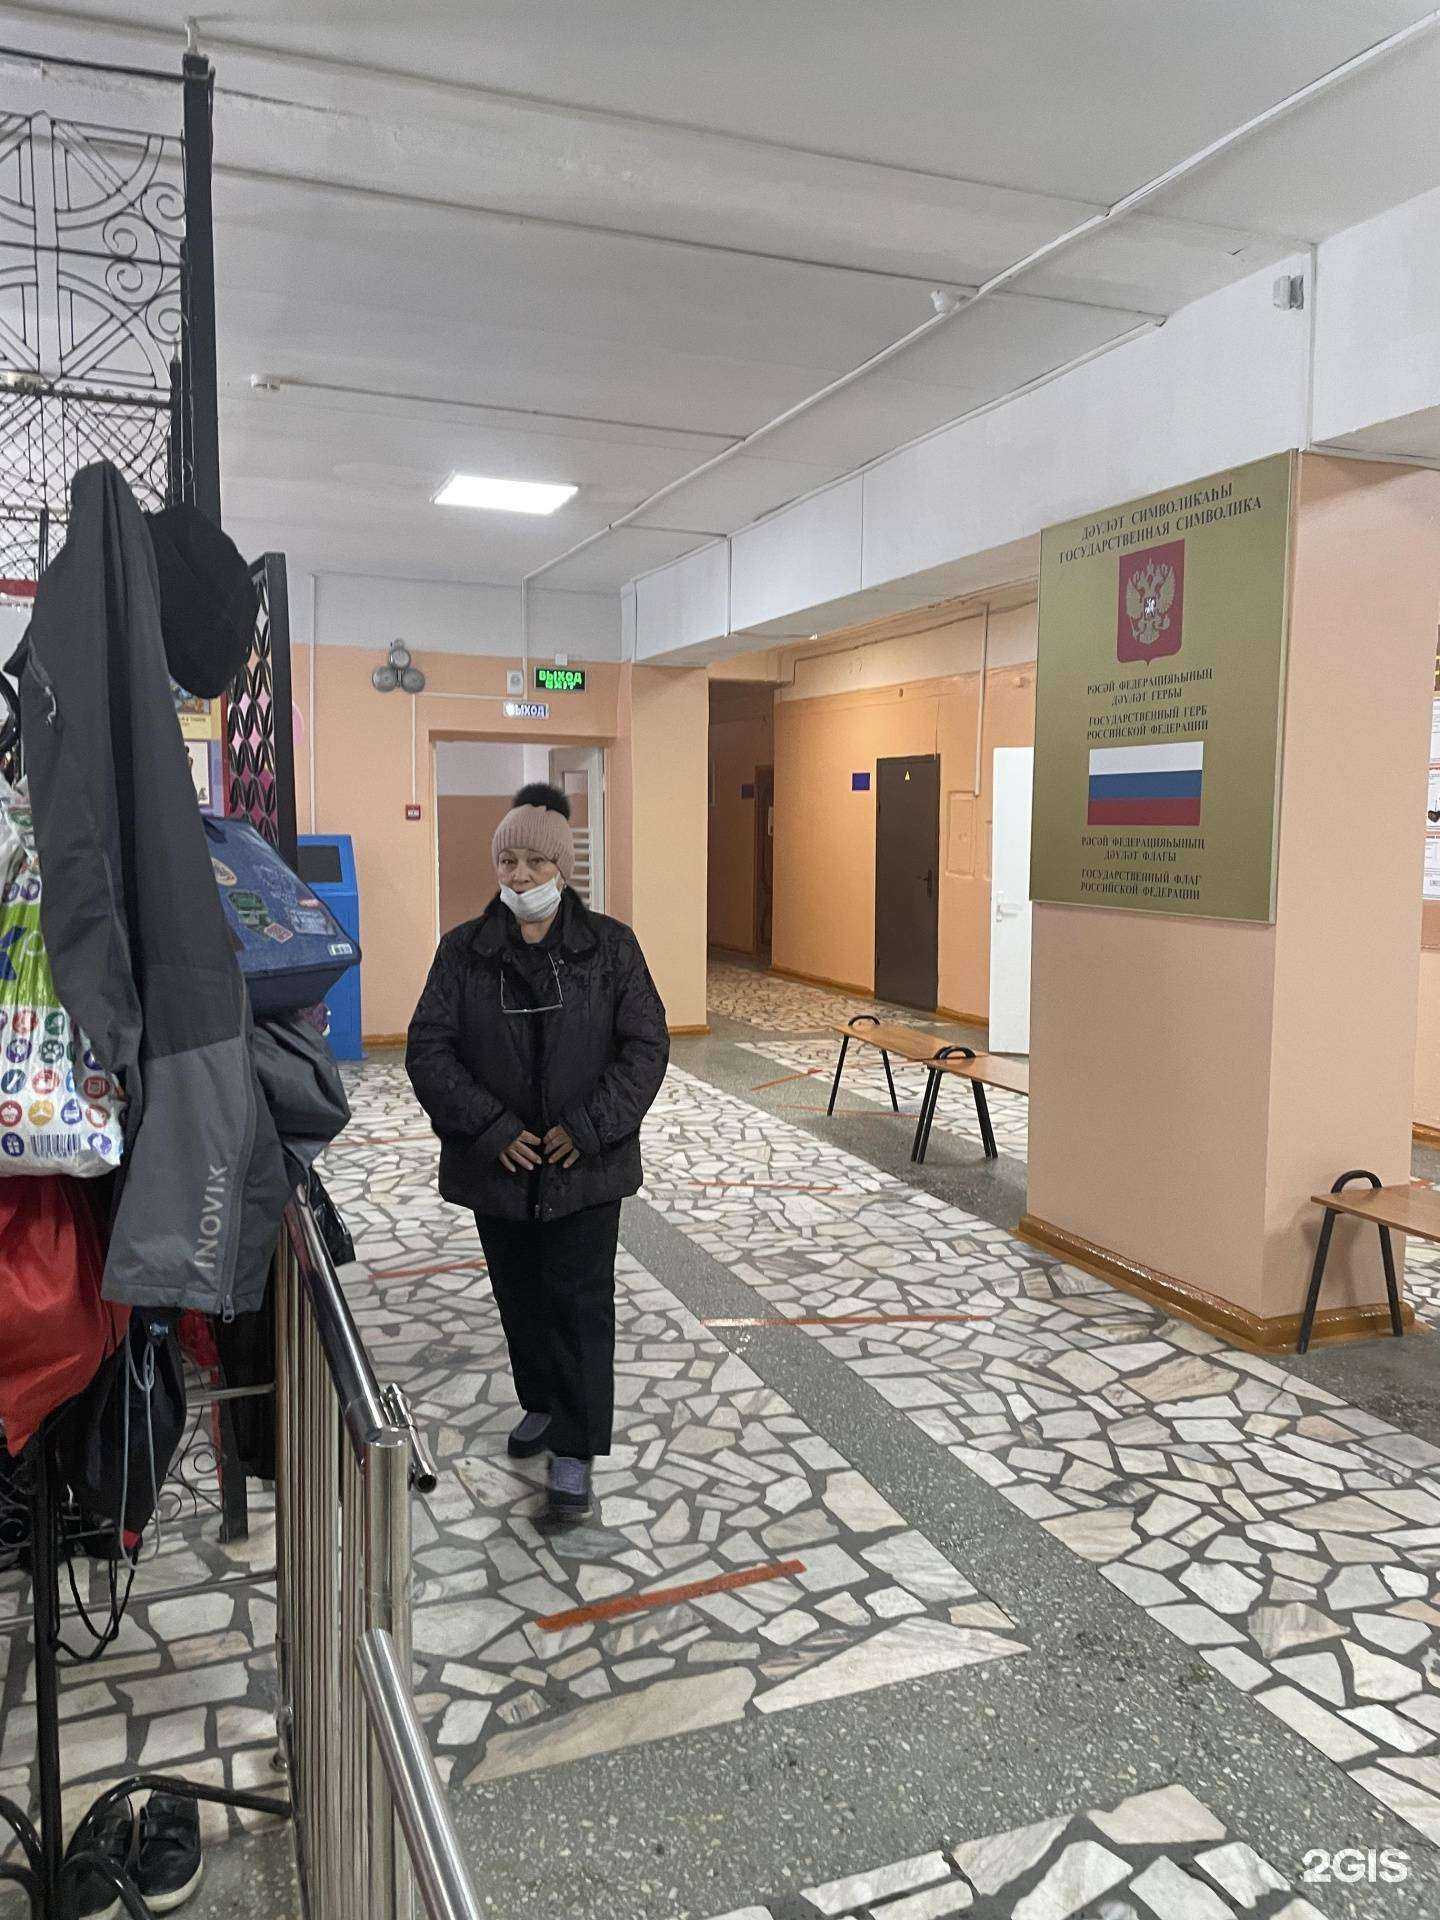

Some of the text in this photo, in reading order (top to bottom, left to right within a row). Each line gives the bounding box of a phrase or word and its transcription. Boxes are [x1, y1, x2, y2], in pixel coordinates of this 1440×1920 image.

[1059, 496, 1262, 564] ГОСУДАРСТВЕННАЯ СИМВОЛИКА
[538, 670, 582, 685] ВЫХОД
[505, 702, 545, 718] ЫХОД
[1089, 704, 1208, 726] ГОСУДАРСТВЕННЫЙ ГЕРБ
[1087, 719, 1208, 740] РОССИЙСКОЙ ФЕДЕРАЦИИ
[1081, 868, 1202, 885] ГОСУДАРСТВЕННЫЙ ФЛАГ
[1080, 881, 1200, 900] РОССИЙСКОЙ ФЕДЕРАЦИИ
